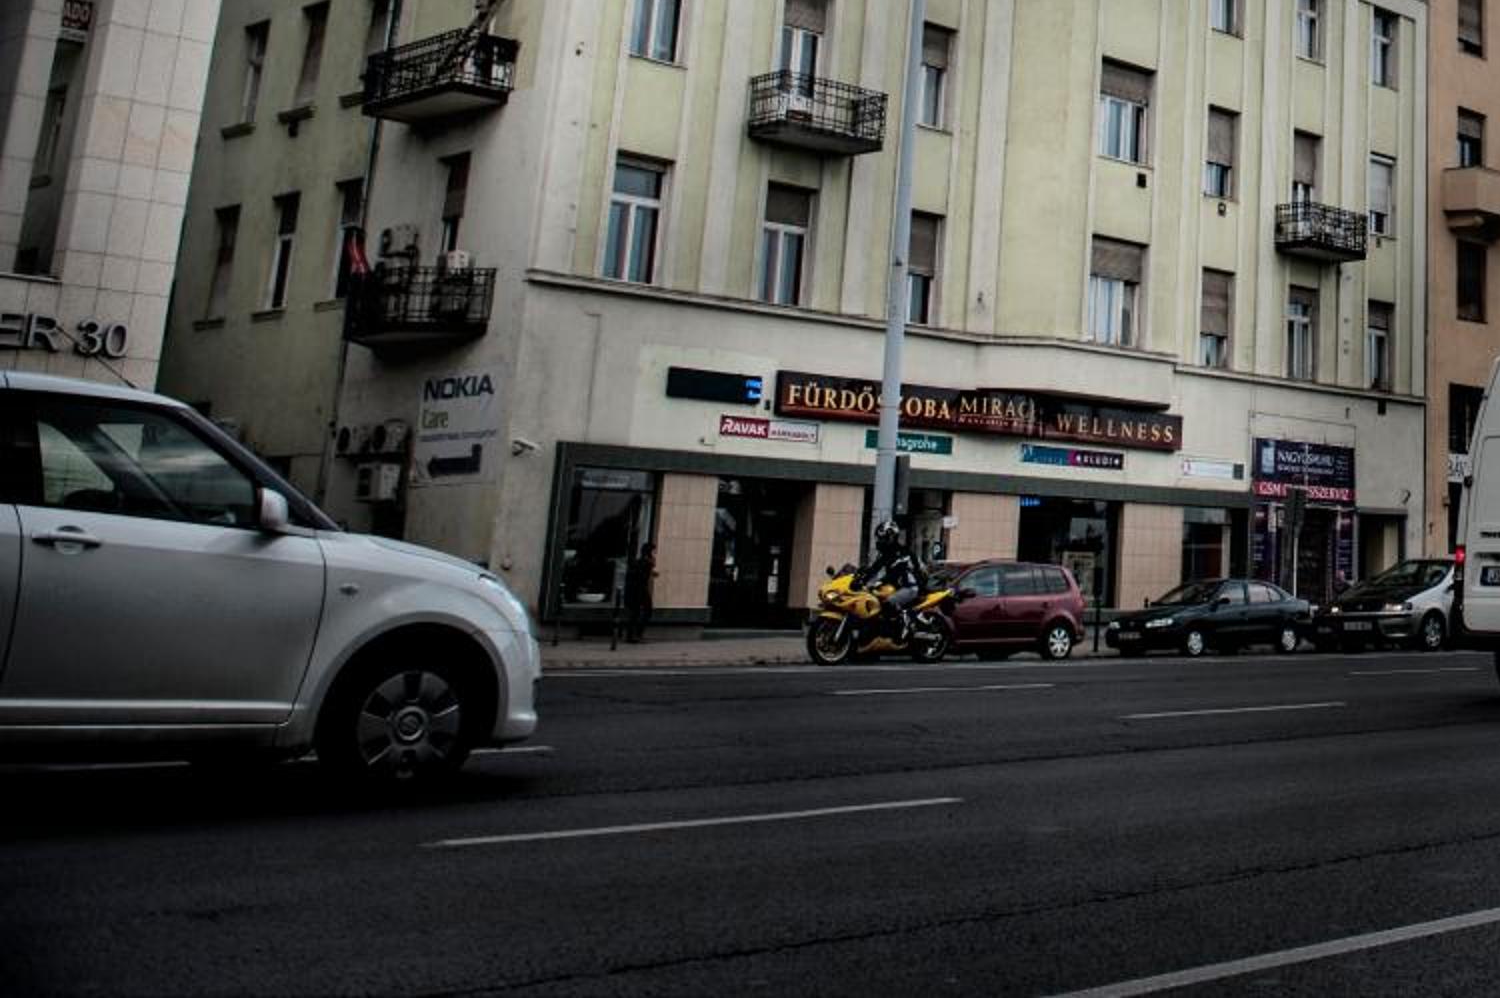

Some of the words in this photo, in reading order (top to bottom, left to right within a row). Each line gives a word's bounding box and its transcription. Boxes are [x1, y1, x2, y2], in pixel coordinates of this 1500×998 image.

[76, 318, 128, 358] 30
[422, 373, 494, 402] NOKIA
[721, 418, 767, 437] RAVAK
[787, 381, 950, 420] FÜRDŐOBA
[1056, 413, 1174, 443] WELLNESS
